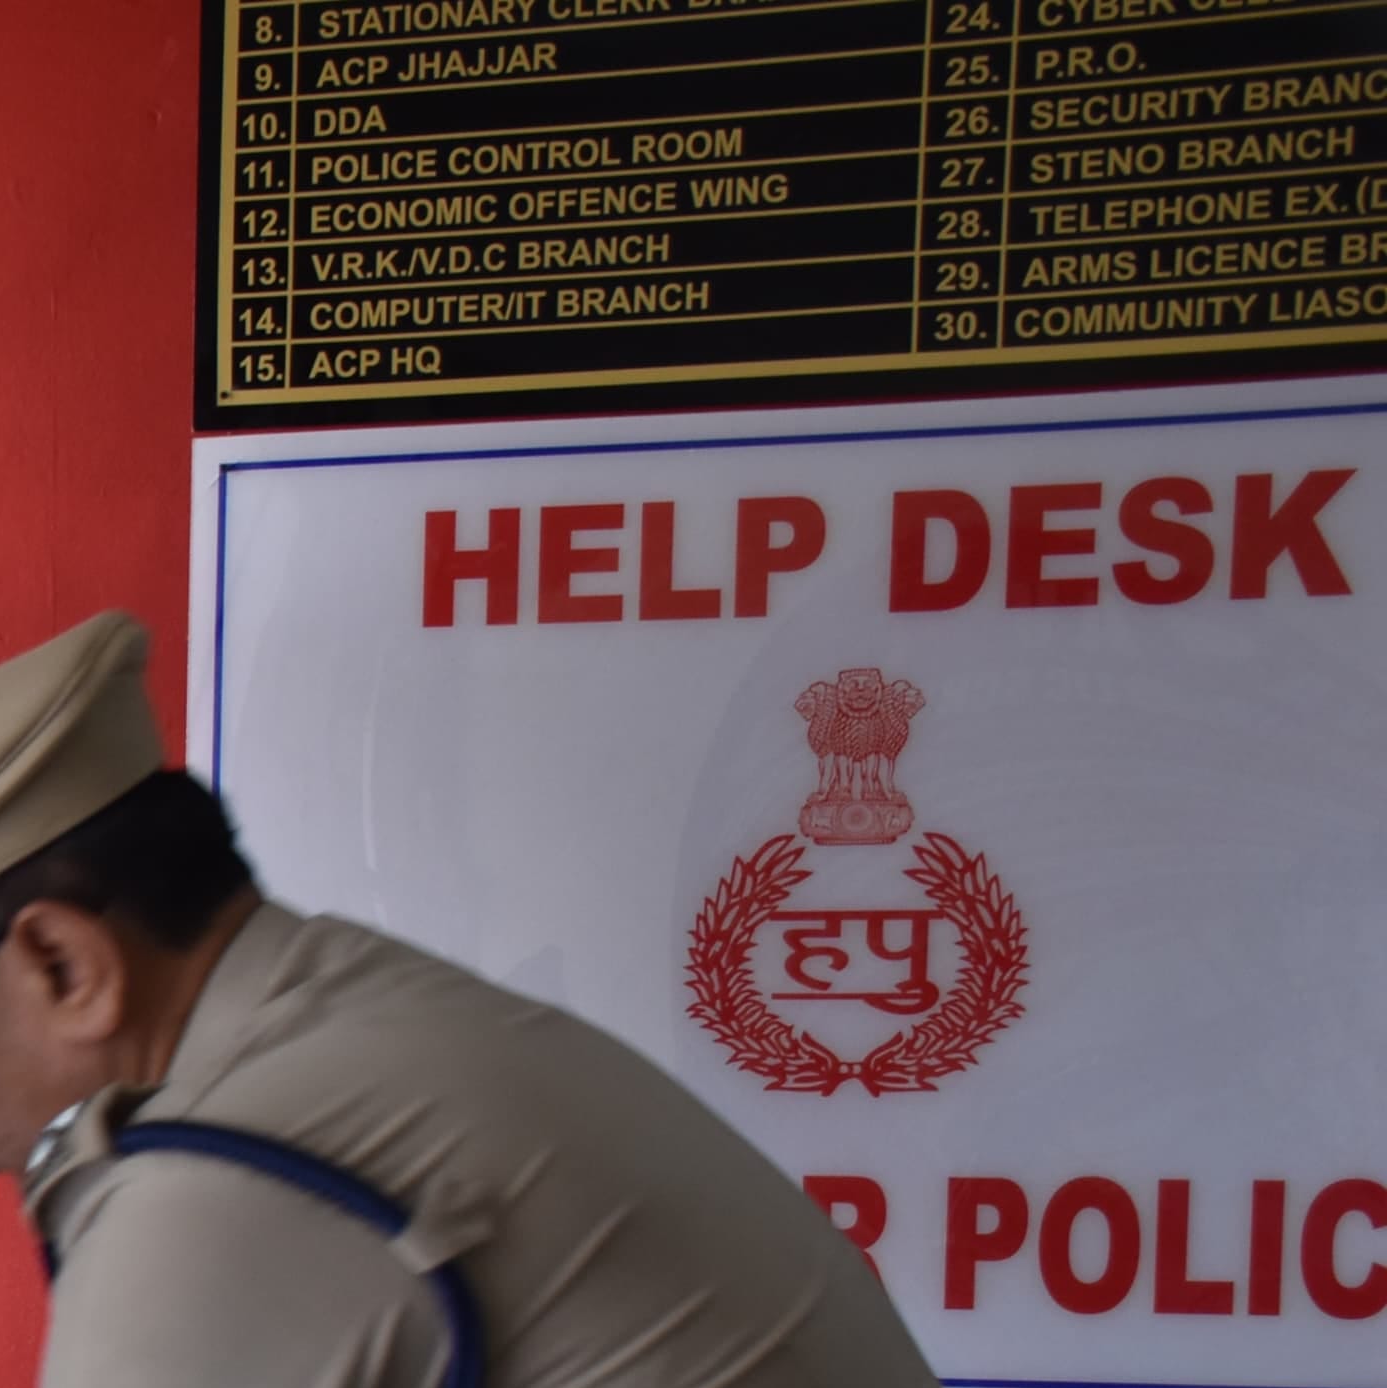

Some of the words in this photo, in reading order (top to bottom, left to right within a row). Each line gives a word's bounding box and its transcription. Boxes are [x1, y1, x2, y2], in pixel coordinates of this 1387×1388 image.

[255, 15, 282, 43] 8.
[318, 0, 532, 40] STATIONARY
[945, 2, 1001, 33] 24.
[254, 64, 281, 91] 9.
[316, 55, 388, 88] ACP
[398, 42, 558, 82] JHAJJAR
[945, 56, 1000, 87] 25.
[1035, 41, 1146, 80] P.R.O.
[242, 112, 287, 142] 10.
[313, 105, 387, 137] DDA
[945, 106, 1000, 137] 26.
[1030, 84, 1232, 131] SECURITY
[242, 160, 285, 190] 11.
[311, 149, 438, 185] POLICE
[447, 137, 621, 178] CONTROL
[631, 127, 744, 163] ROOM
[941, 157, 995, 188] 27.
[1030, 143, 1165, 183] STENO
[1177, 126, 1355, 170] BRANCH
[242, 208, 287, 239] 12.
[310, 193, 498, 234] ECONOMIC
[508, 182, 678, 221] OFFENCE
[690, 172, 790, 210] WING
[937, 210, 991, 240] 28.
[1030, 187, 1273, 236] TELEPHONE
[1285, 184, 1348, 216] EX.
[241, 258, 286, 286] 13.
[518, 234, 670, 270] BRANCH
[937, 262, 990, 292] 29.
[1023, 250, 1137, 288] ARMS
[1150, 236, 1325, 281] LICENCE
[239, 307, 283, 336] 14.
[310, 289, 546, 331] COMPUTER/IT
[556, 281, 710, 319] BRANCH
[934, 312, 988, 341] 30.
[1015, 294, 1258, 339] COMMUNITY
[238, 354, 284, 383] 15.
[309, 349, 380, 380] ACP
[390, 345, 442, 376] HQ
[422, 495, 827, 628] HELP
[887, 467, 1359, 614] DESK
[943, 1174, 1387, 1321] POLIC
